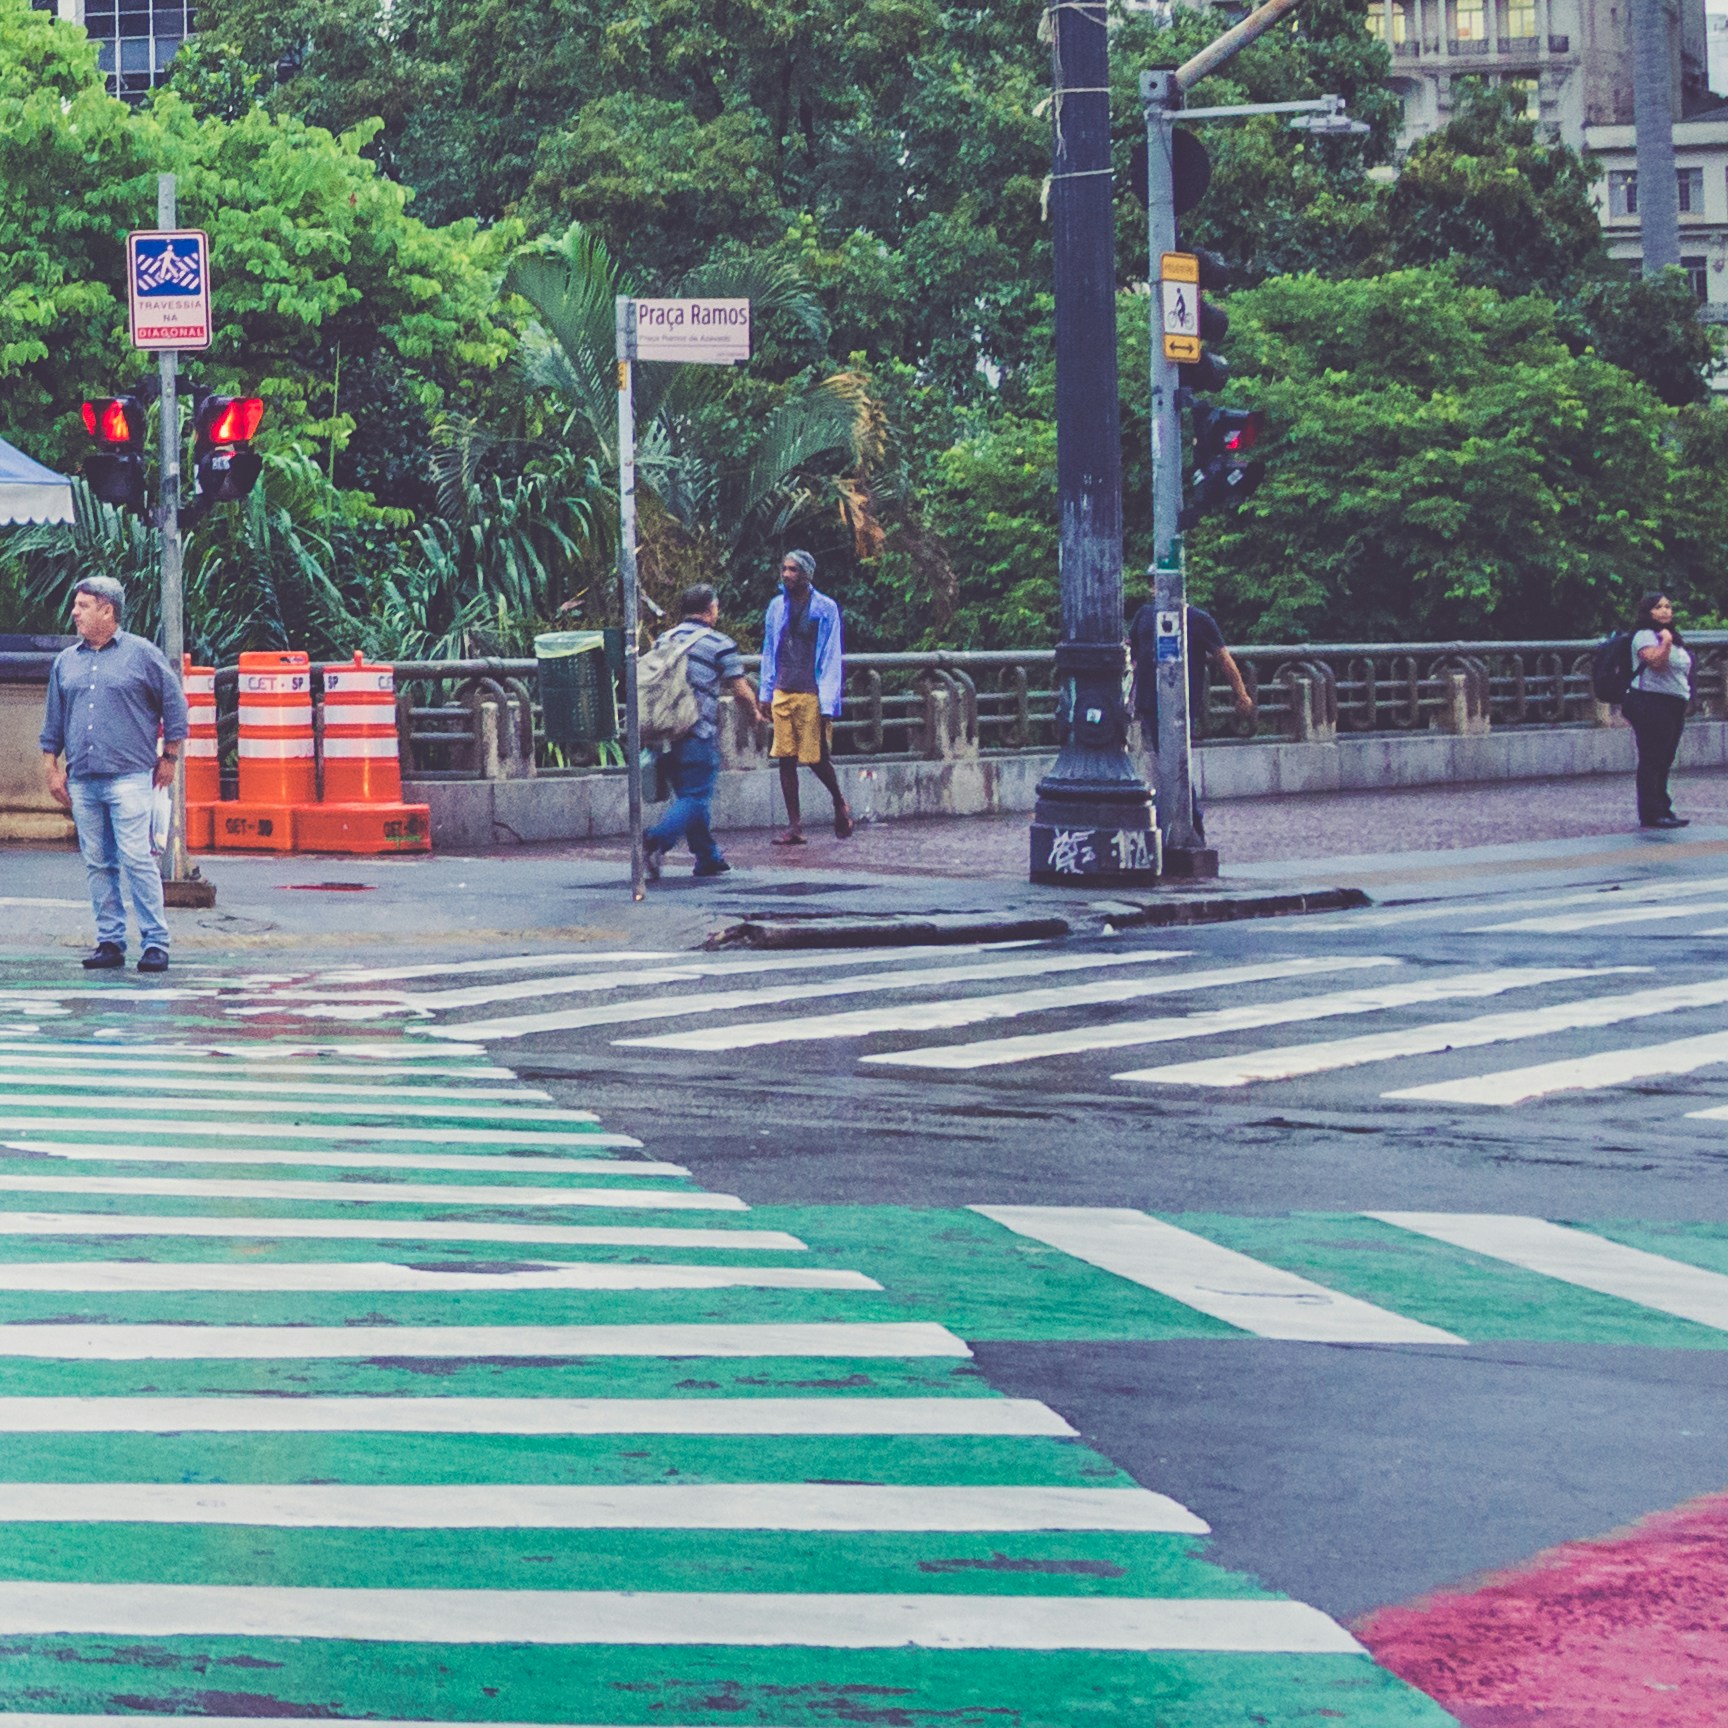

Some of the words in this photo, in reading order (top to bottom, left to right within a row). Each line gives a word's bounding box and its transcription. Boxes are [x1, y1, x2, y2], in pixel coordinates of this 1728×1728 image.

[139, 300, 201, 310] TRAVESSIA
[163, 314, 178, 322] NA
[639, 304, 684, 331] Praça
[691, 304, 747, 325] Ramos
[138, 327, 204, 338] DIAGONAL
[248, 677, 278, 691] CET
[292, 677, 304, 690] SP
[328, 675, 339, 689] SP
